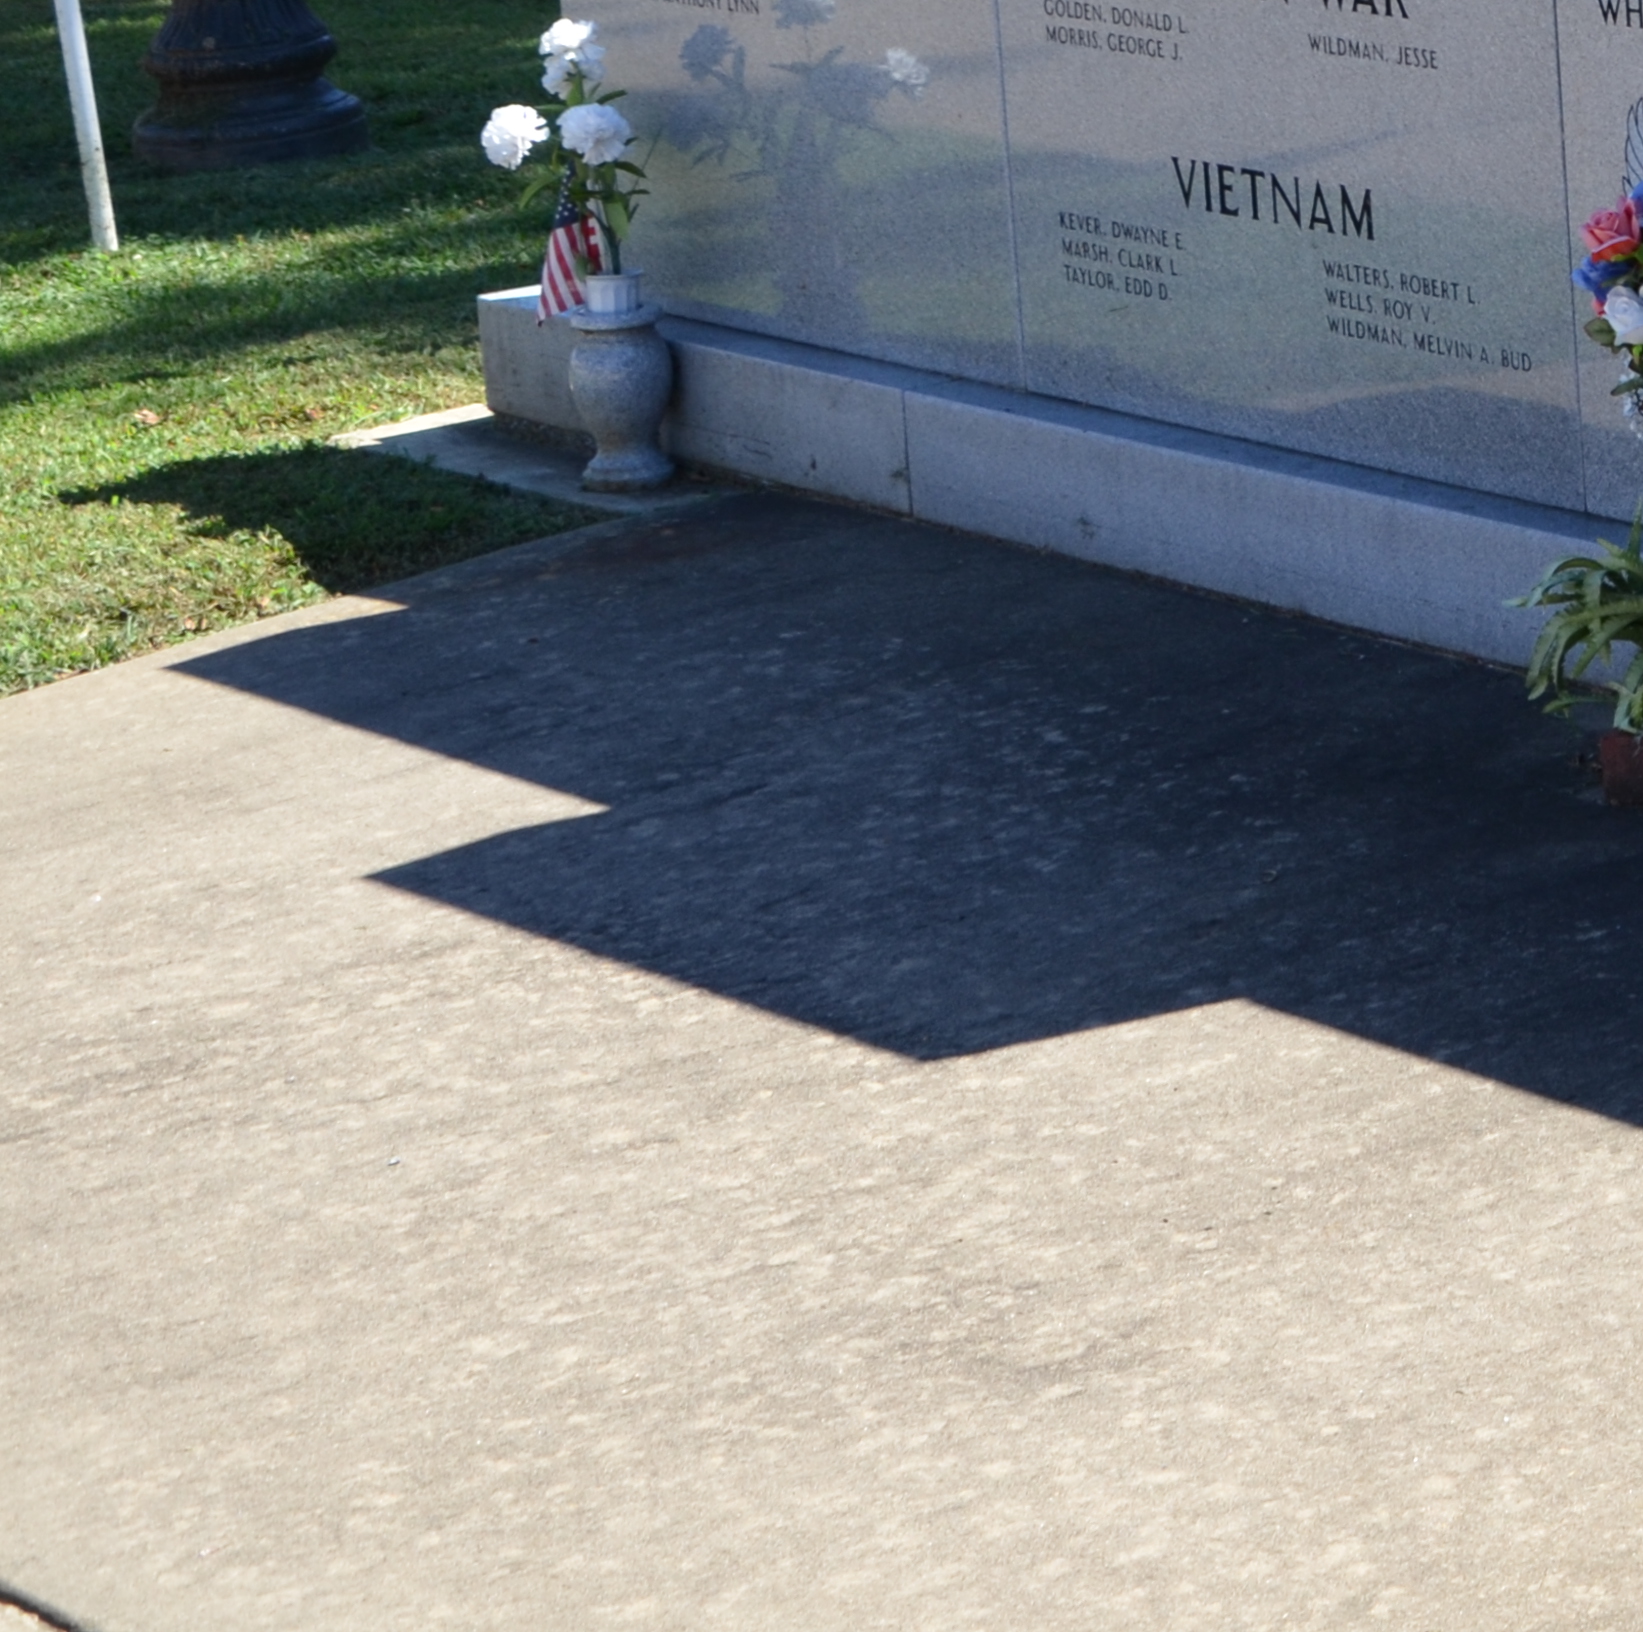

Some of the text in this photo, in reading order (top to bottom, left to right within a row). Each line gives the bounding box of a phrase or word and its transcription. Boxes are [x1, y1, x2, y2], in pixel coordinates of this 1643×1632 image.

[1111, 7, 1172, 32] DONALD
[1107, 33, 1164, 58] GEORGE
[1397, 47, 1437, 69] JESSE
[1171, 156, 1375, 241] VIETNAM
[1112, 221, 1168, 247] DWAYNE
[1118, 249, 1163, 273] CLARK
[1125, 277, 1152, 297] EDD
[1400, 273, 1459, 300] ROBERT
[1383, 299, 1411, 319] ROY
[1414, 333, 1472, 359] MELVIN
[1501, 349, 1532, 372] BUD
